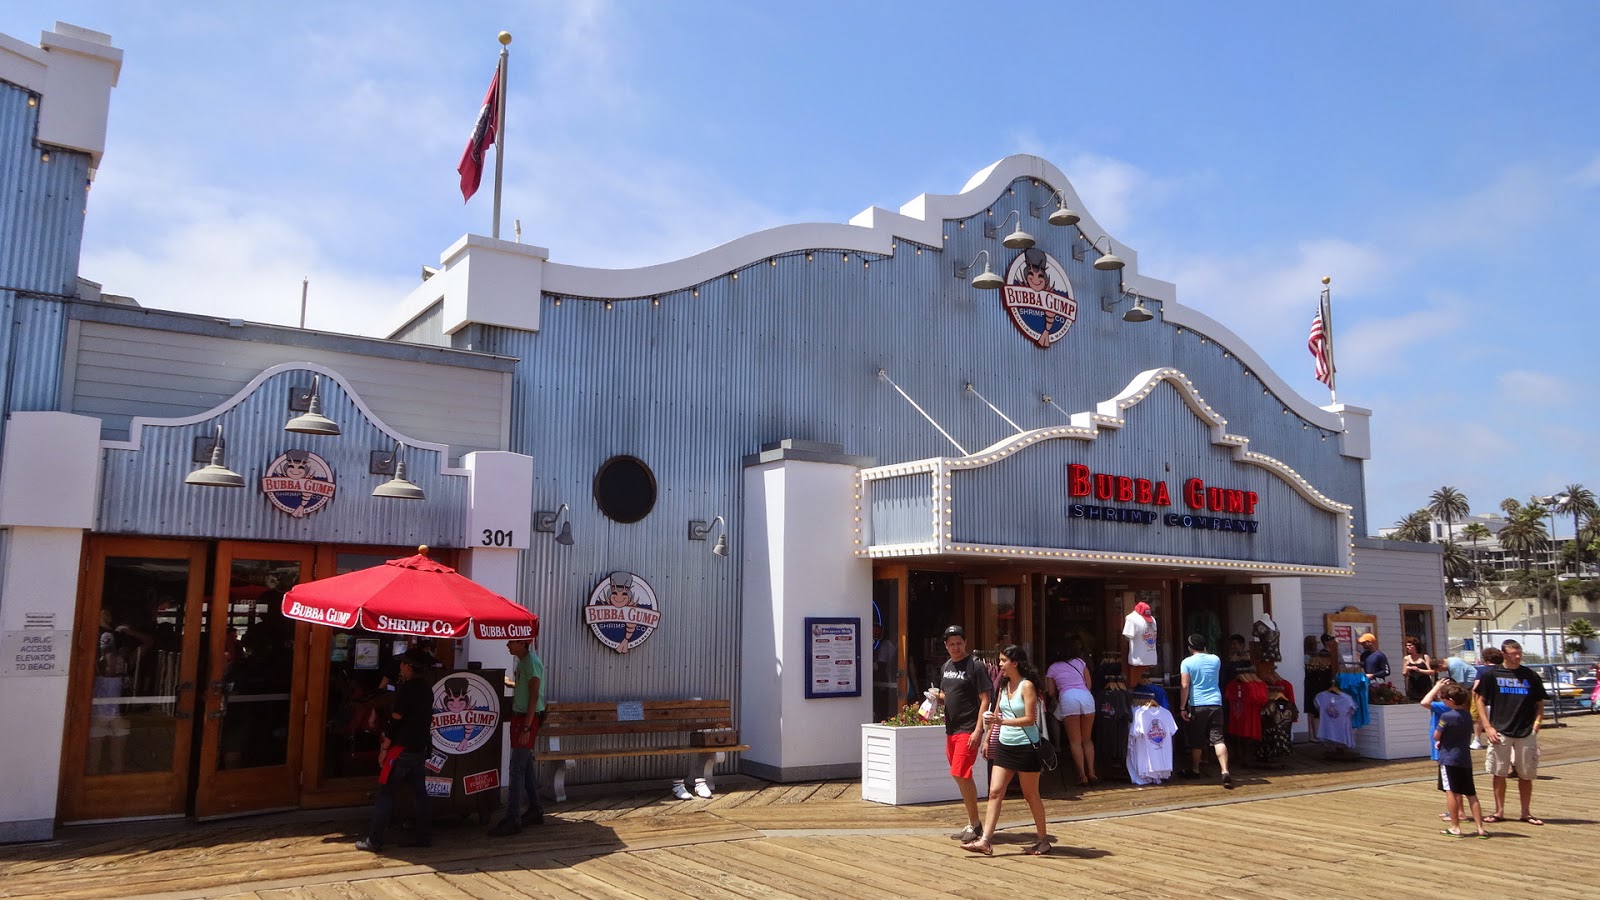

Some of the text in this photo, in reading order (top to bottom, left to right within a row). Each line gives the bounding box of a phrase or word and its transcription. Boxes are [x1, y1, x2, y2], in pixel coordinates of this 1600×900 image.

[1007, 288, 1075, 316] BUBBA GUMP
[1019, 308, 1065, 323] SHRIMP CO
[1055, 321, 1071, 338] MARKET
[265, 479, 334, 494] BUBBA GUMP
[1067, 463, 1259, 514] BUBBA GUMP
[1069, 504, 1259, 533] SHRIMP COMPANY
[482, 529, 513, 547] 301
[289, 601, 351, 624] BUBBA GUMP
[588, 607, 658, 625] BUBBA GUMP
[377, 615, 455, 635] SHRIMP CO.
[479, 623, 533, 637] BUBBA GUMP
[1496, 677, 1530, 688] UCLA
[465, 711, 495, 725] GUMP
[427, 783, 449, 792] SPECIAL
